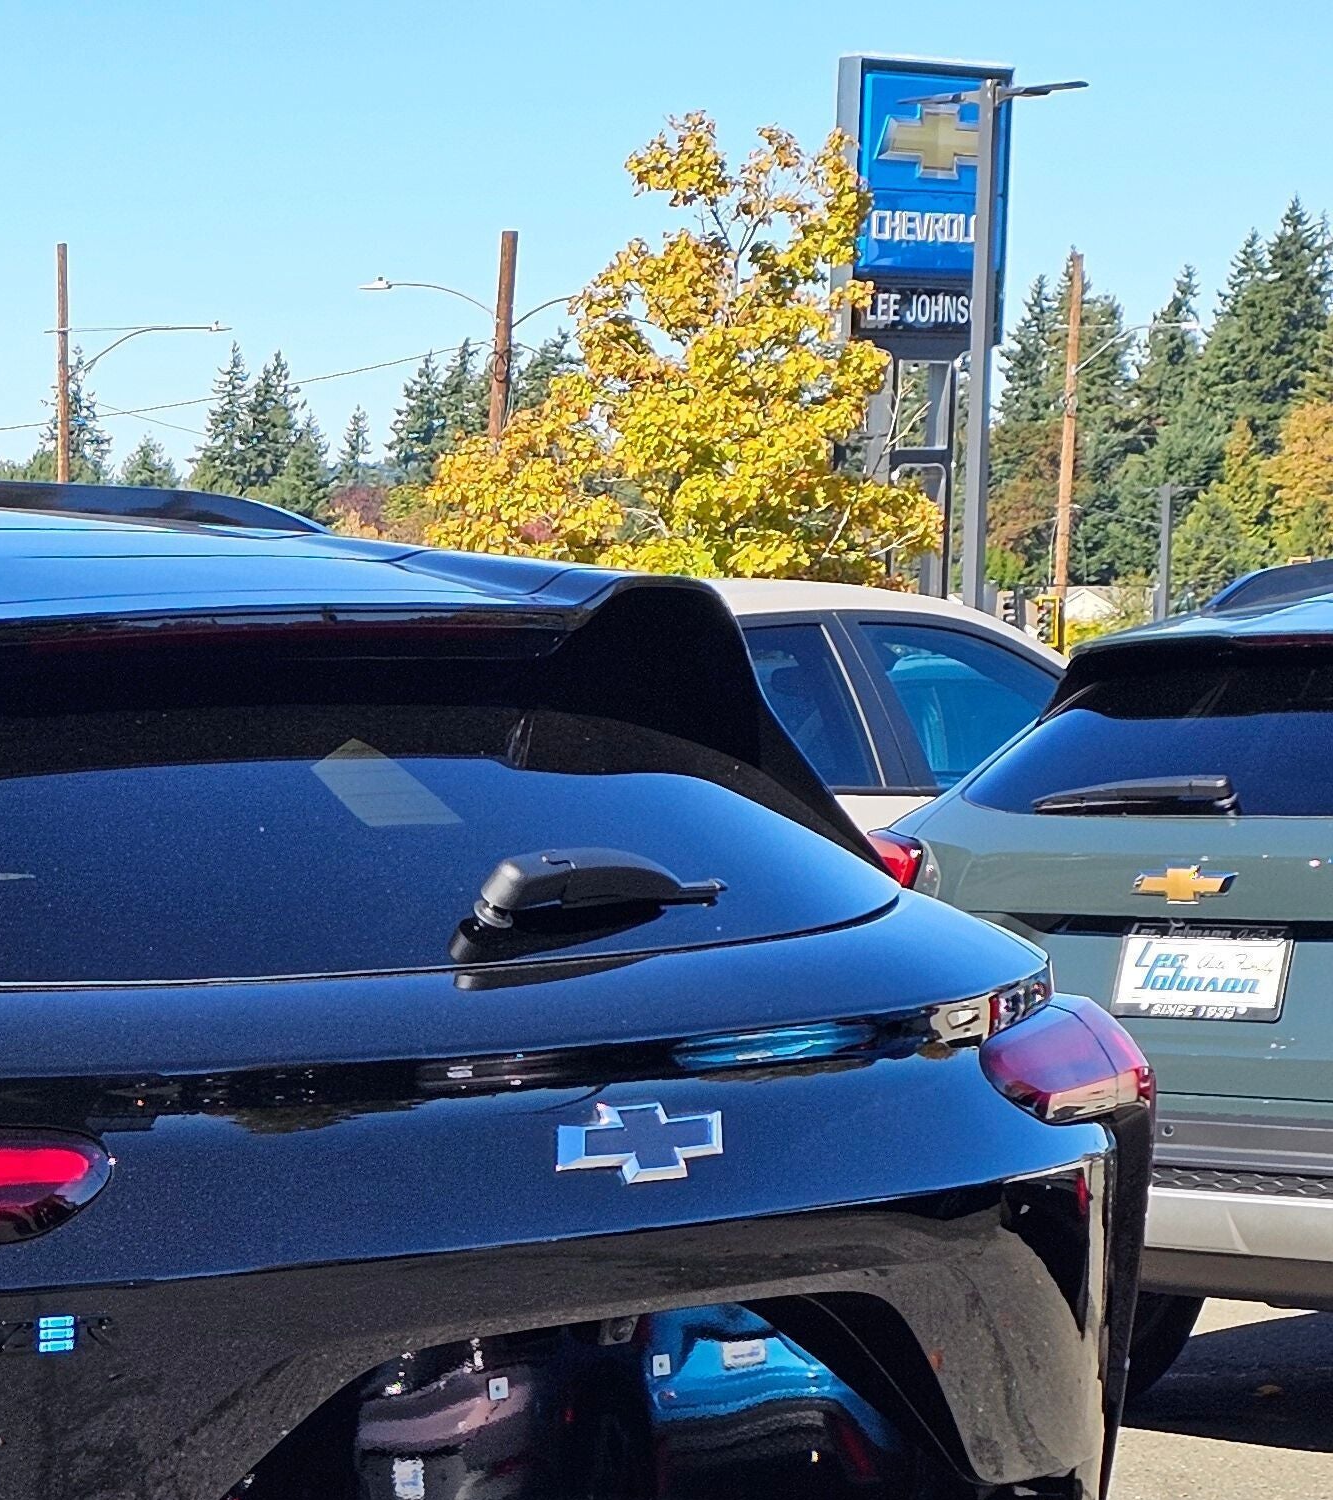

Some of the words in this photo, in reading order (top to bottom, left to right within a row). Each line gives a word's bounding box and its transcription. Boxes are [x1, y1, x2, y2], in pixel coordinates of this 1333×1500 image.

[871, 210, 976, 242] CHEVROL
[866, 293, 901, 321] LEE
[905, 294, 973, 323] JOHNS
[1134, 941, 1189, 968] Lee
[1134, 963, 1260, 994] Johnson
